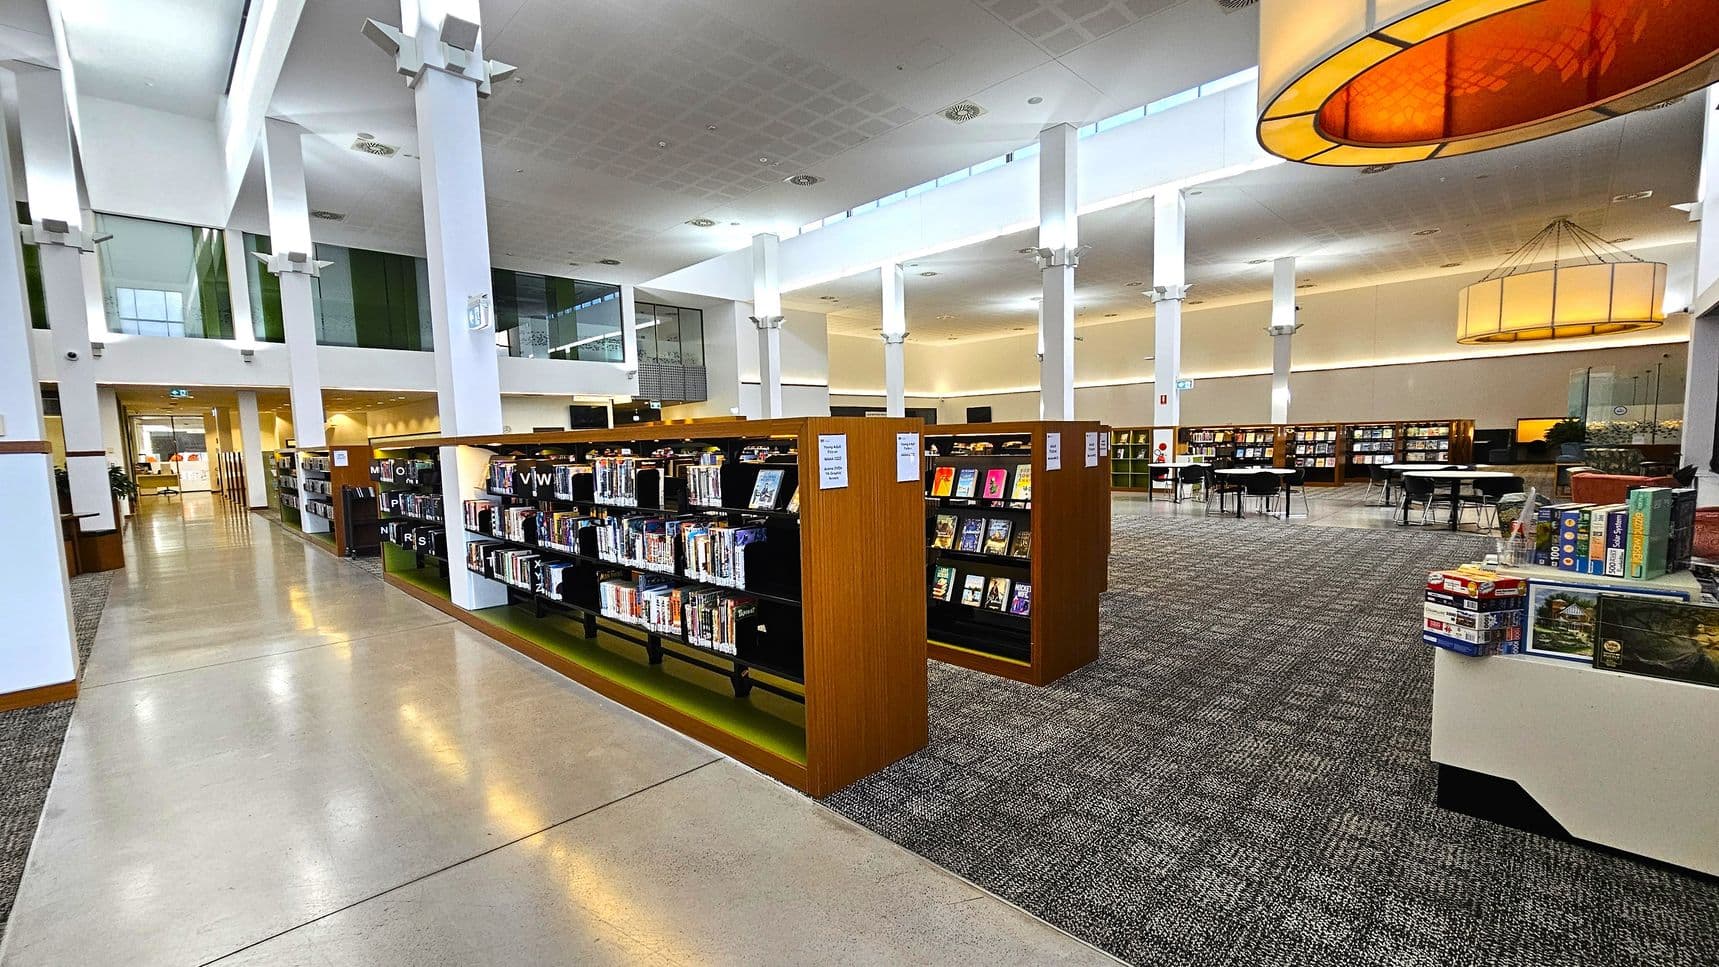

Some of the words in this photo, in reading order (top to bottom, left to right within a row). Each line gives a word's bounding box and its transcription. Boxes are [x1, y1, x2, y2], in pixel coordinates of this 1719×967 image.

[370, 466, 380, 474] M
[396, 467, 405, 476] O
[519, 472, 530, 485] V
[536, 473, 552, 486] W
[391, 500, 399, 508] P
[1613, 514, 1623, 534] System
[380, 526, 388, 534] N
[404, 533, 413, 542] R
[418, 536, 427, 546] S
[1612, 532, 1620, 548] Solar
[1550, 546, 1560, 561] 100
[534, 559, 542, 569] X
[1608, 562, 1616, 574] 500
[534, 571, 542, 580] Y
[535, 583, 544, 592] Z
